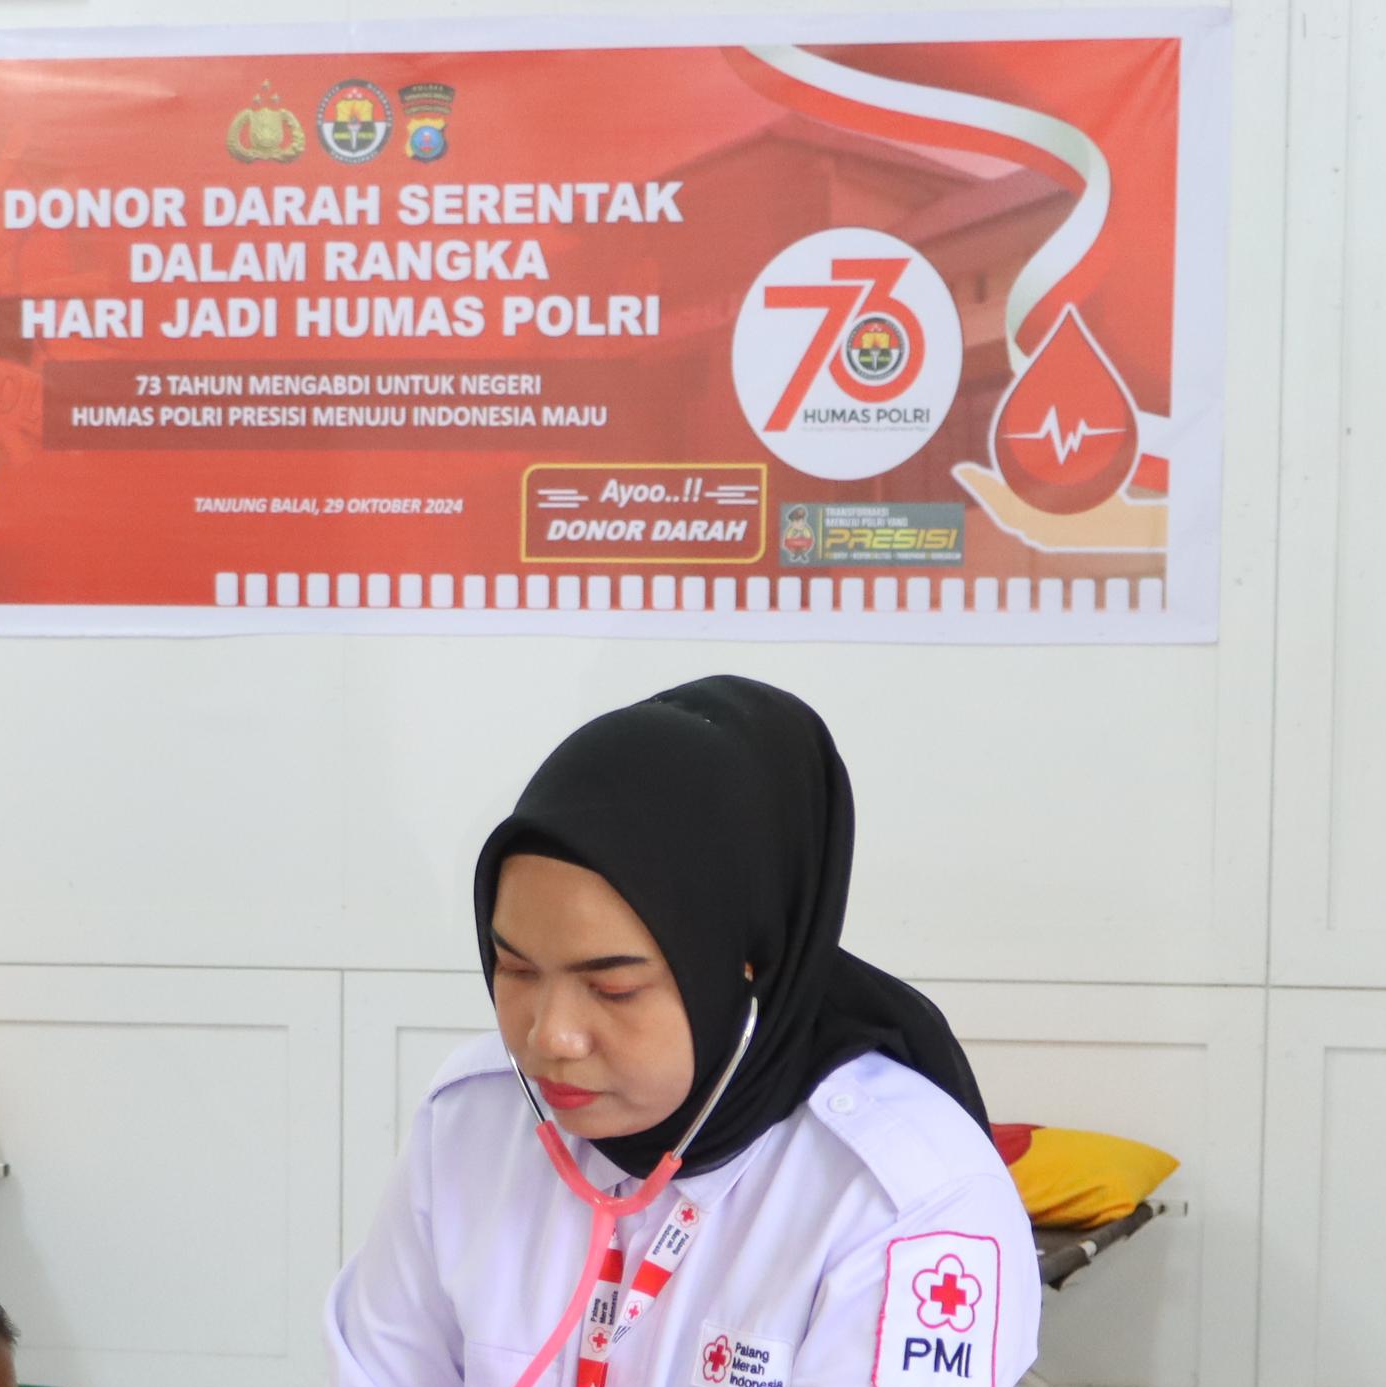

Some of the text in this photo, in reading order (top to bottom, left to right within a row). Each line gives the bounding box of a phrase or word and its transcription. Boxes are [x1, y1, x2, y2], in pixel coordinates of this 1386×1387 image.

[4, 181, 684, 229] DONOR DARAH SERENTAK
[130, 239, 549, 283] DALAM RANGKA
[21, 295, 660, 339] HARI JADI HUMAS POLRI
[763, 258, 926, 432] 73
[136, 374, 542, 396] 73 TAHUN MENGABDI UNTUK NEGERI
[71, 405, 607, 427] HUMAS POLRI PRESISI MENUJU INDONESIA MAJU
[804, 408, 931, 424] HUMAS POLRI
[194, 497, 463, 515] TANJUNG BALAI, 29 OKTOBER 2024
[546, 519, 747, 541] DONOR DARAH
[825, 528, 958, 549] PRESISI
[735, 1342, 769, 1363] Palang
[903, 1337, 973, 1378] PMI
[732, 1357, 765, 1375] Merah
